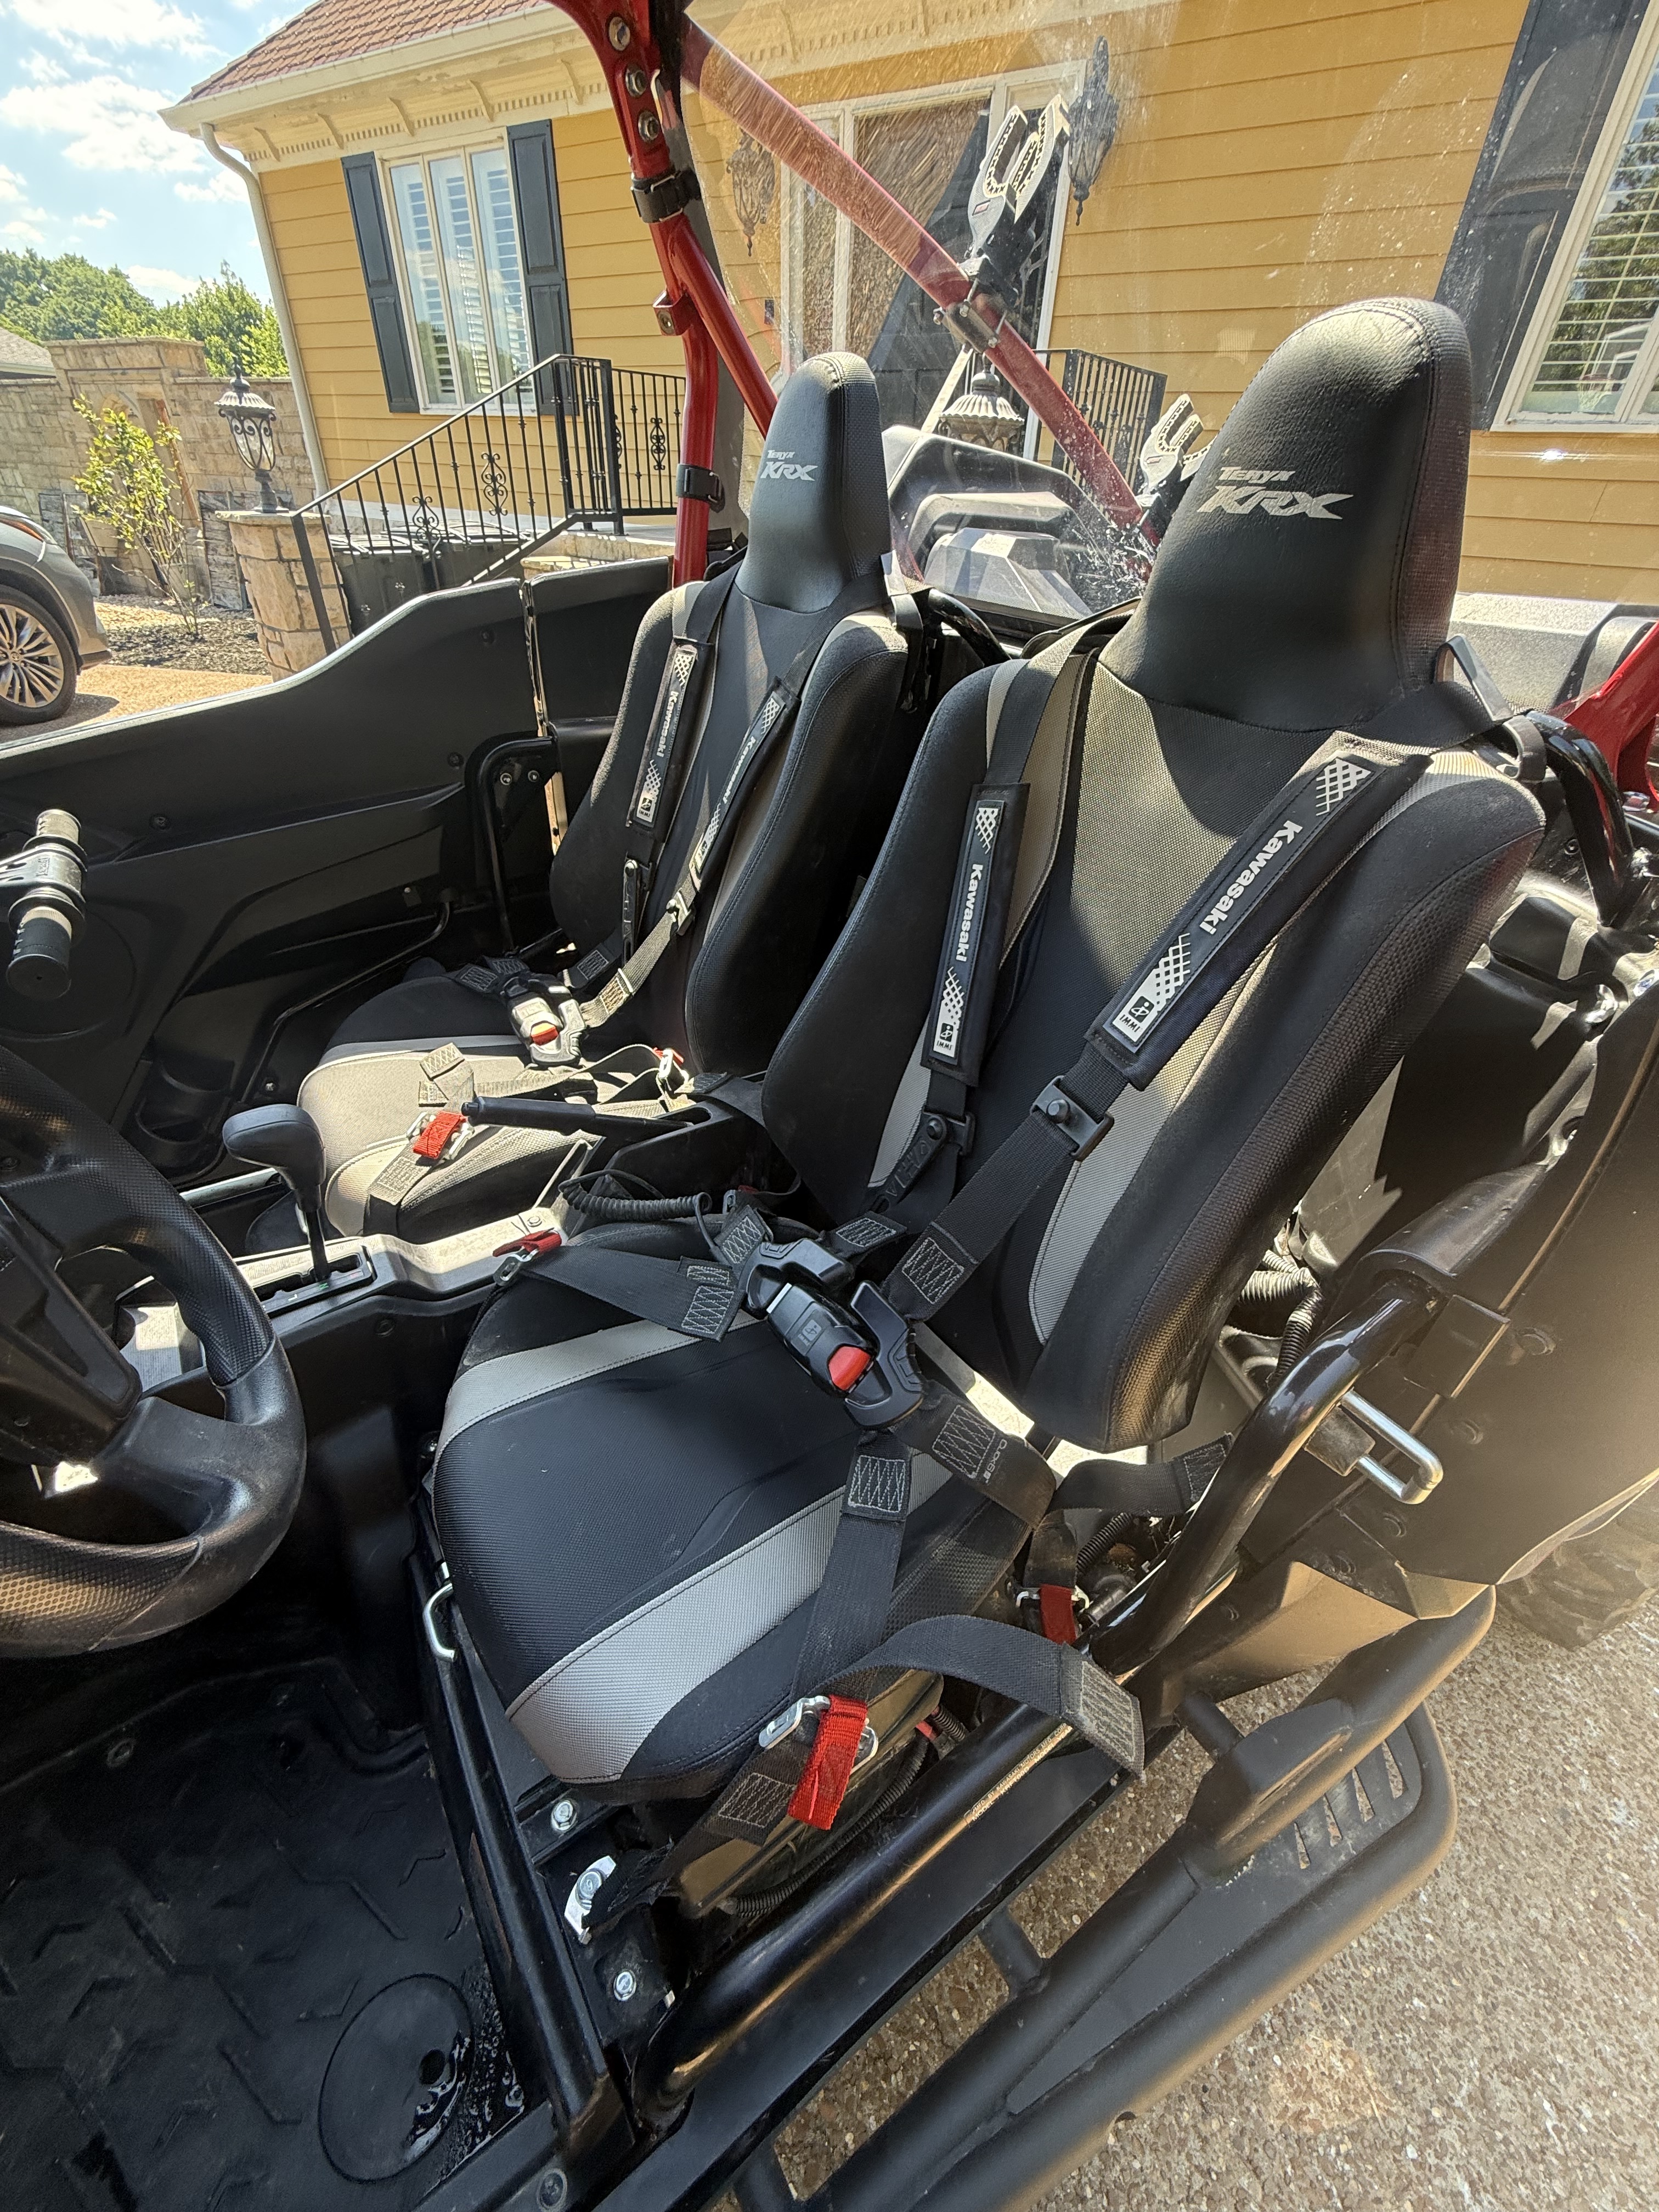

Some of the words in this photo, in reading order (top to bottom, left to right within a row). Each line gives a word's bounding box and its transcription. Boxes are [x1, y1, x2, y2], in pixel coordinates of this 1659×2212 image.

[760, 461, 818, 481] KRX
[1197, 486, 1354, 520] KRX
[656, 691, 679, 758] Kawasaki
[723, 736, 756, 804] Kawasaki
[1199, 820, 1304, 935] Kawasaki
[956, 864, 984, 962] Kawasaki
[1120, 1014, 1141, 1033] IMMI
[936, 1040, 952, 1051] IMMI
[996, 1767, 1019, 1791] KAWASAKI
